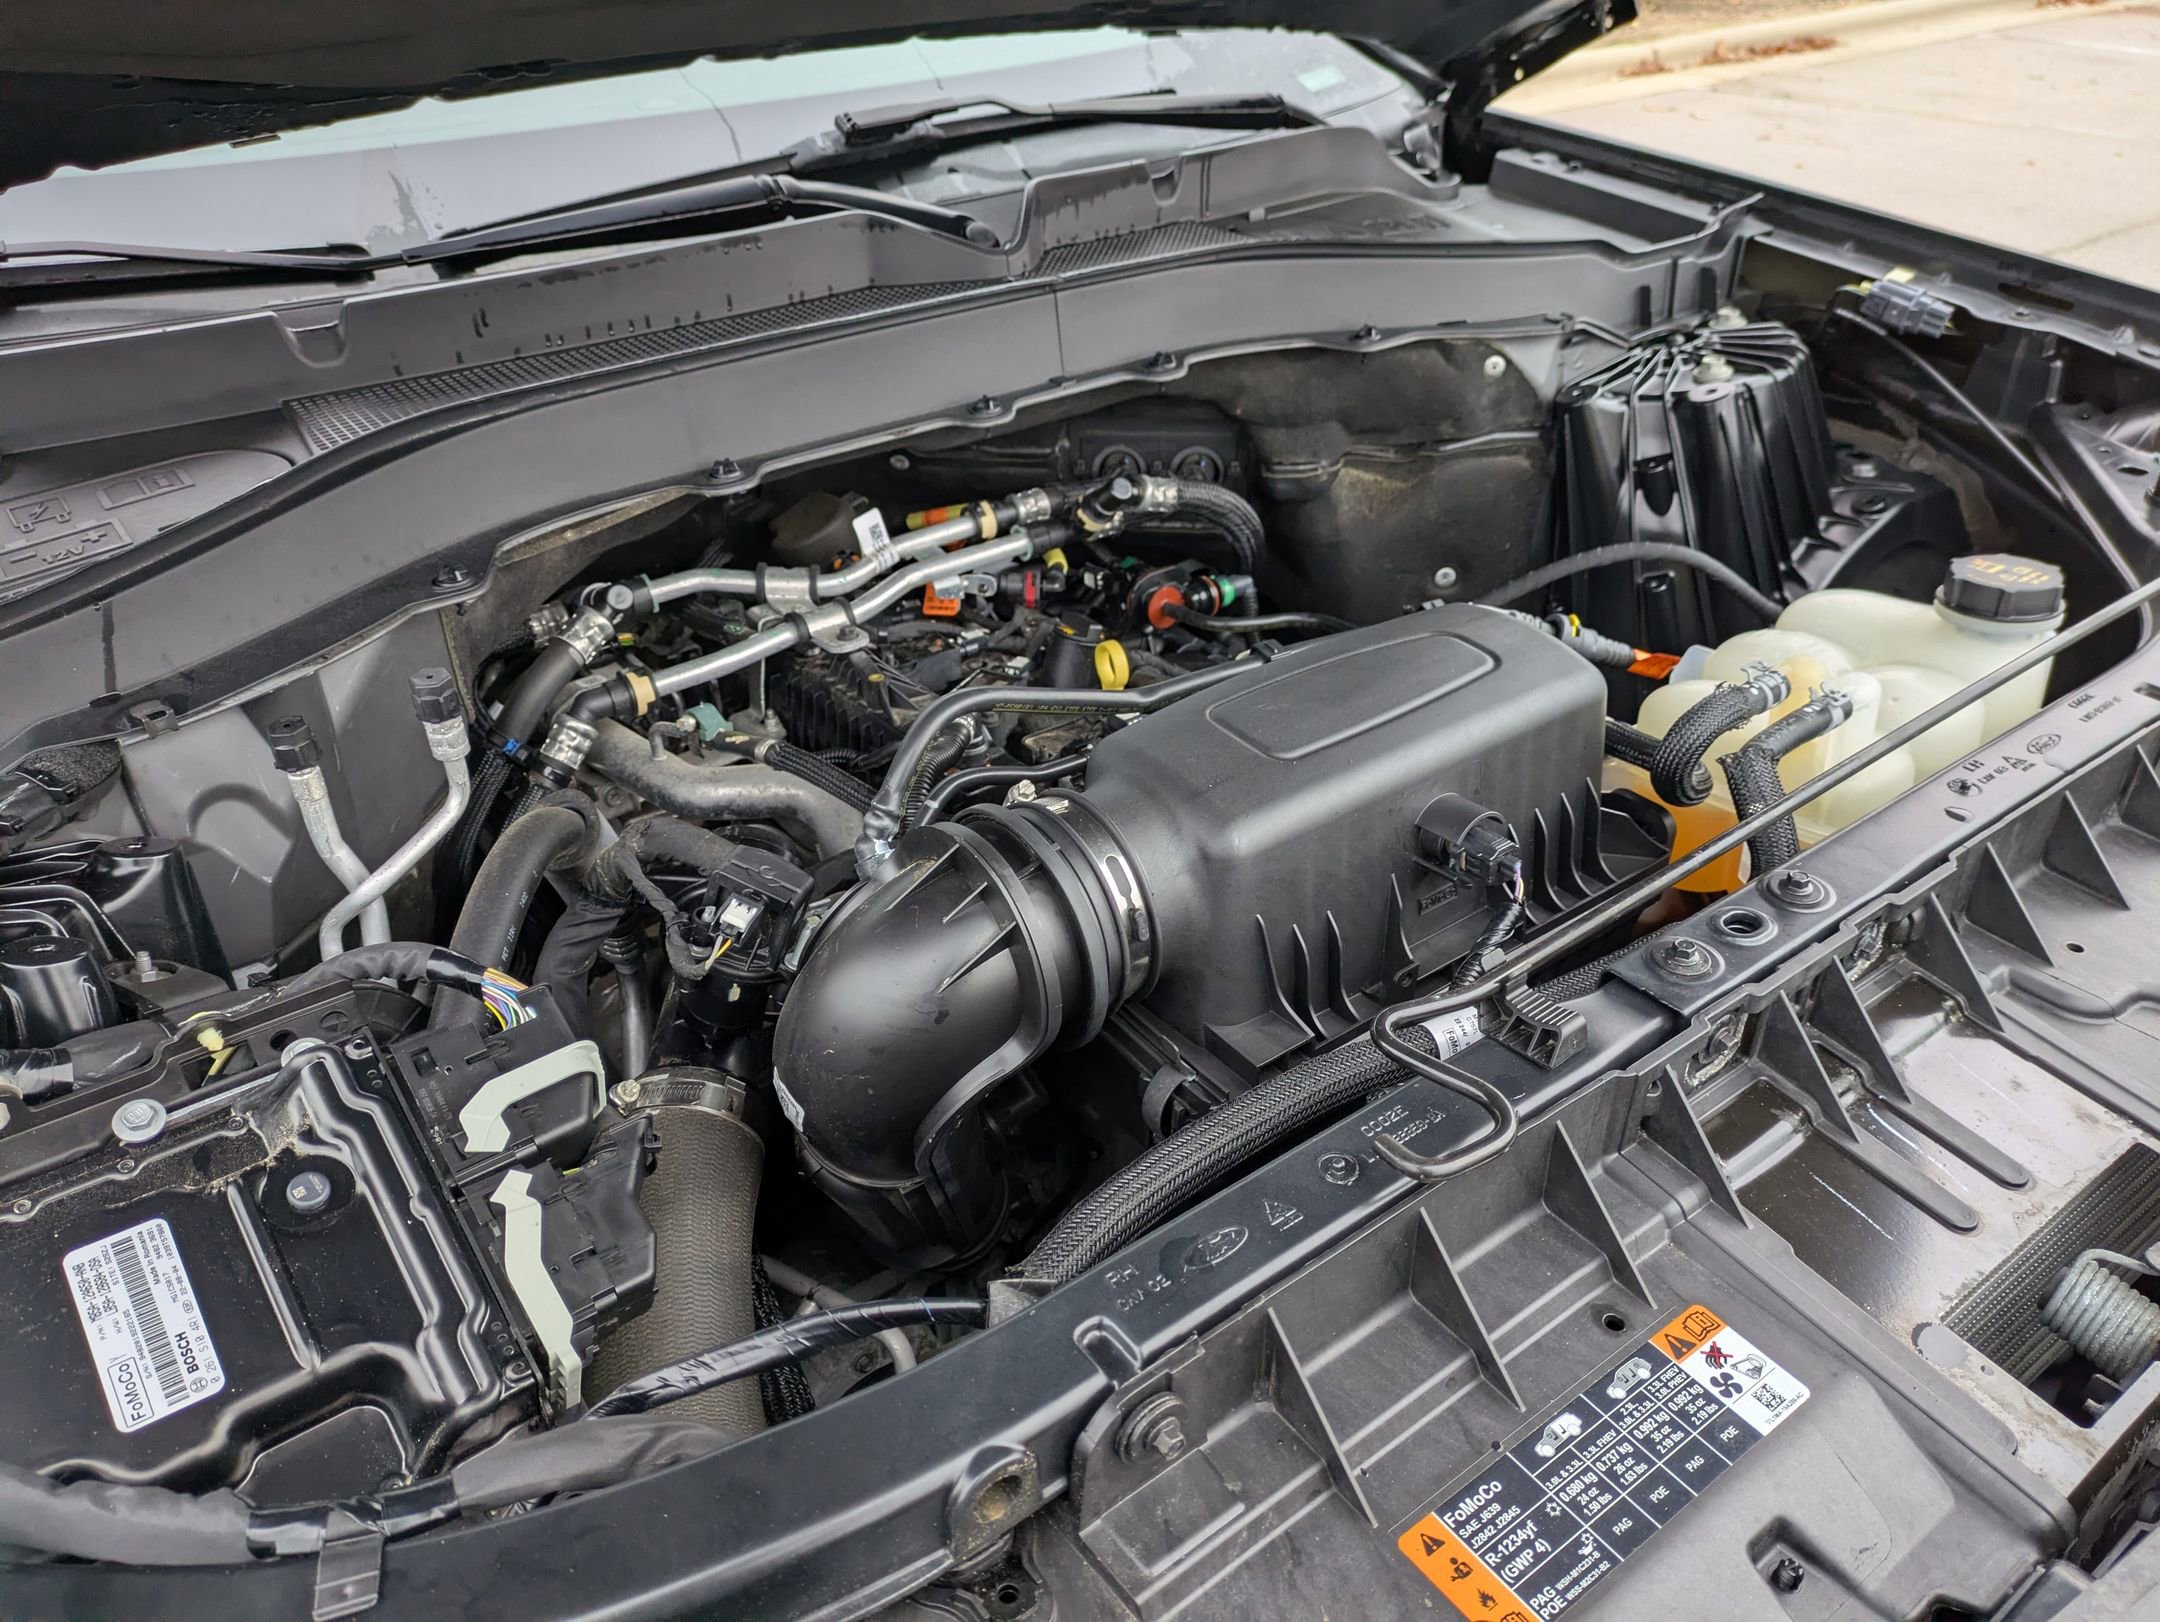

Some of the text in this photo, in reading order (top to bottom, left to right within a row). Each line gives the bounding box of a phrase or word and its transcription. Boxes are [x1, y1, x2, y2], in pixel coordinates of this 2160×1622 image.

[42, 545, 85, 564] 12V
[136, 1230, 151, 1258] Romania
[149, 1265, 161, 1284] Made
[174, 1330, 199, 1374] BOSCH
[203, 1356, 216, 1373] 261
[114, 1361, 147, 1422] FoMoCo
[1646, 1365, 1680, 1393] 3.3L FHEV
[1653, 1370, 1688, 1399] 3.0L PHEV
[1618, 1398, 1640, 1416] 2.3L,
[1666, 1382, 1705, 1412] 0.992 kg
[1684, 1397, 1706, 1414] 35 oz
[1617, 1413, 1636, 1429] 3.0L
[1636, 1397, 1655, 1413] 3.3L
[1632, 1409, 1671, 1440] 0.992 kg
[1690, 1401, 1719, 1425] 2.19 lbs
[1581, 1428, 1618, 1459] 3.3L FHEV
[1650, 1425, 1672, 1442] 35 oz
[1655, 1429, 1685, 1454] 2.19 lbs
[1718, 1424, 1739, 1442] POE
[1594, 1439, 1635, 1472] 0.737 kg
[1612, 1456, 1635, 1474] 26 oz
[1683, 1454, 1706, 1472] PAG
[1544, 1473, 1563, 1490] 3.0L
[1564, 1456, 1584, 1473] 3.3L
[1558, 1469, 1599, 1503] 0.680 kg
[1618, 1460, 1648, 1486] 1.63 lbs
[1443, 1477, 1504, 1529] FoMoCo
[1576, 1486, 1599, 1505] 24 oz
[1581, 1490, 1613, 1517] 1.50 lbs
[1648, 1484, 1670, 1503] POE
[1458, 1502, 1502, 1539] SAE J639
[1468, 1504, 1521, 1549] J2842 J2845
[1610, 1516, 1633, 1535] PAG
[1484, 1520, 1541, 1568] R-1234yf
[1499, 1536, 1553, 1584] (GWP 4)
[1530, 1586, 1556, 1610] PAG
[1540, 1600, 1567, 1621] POE
